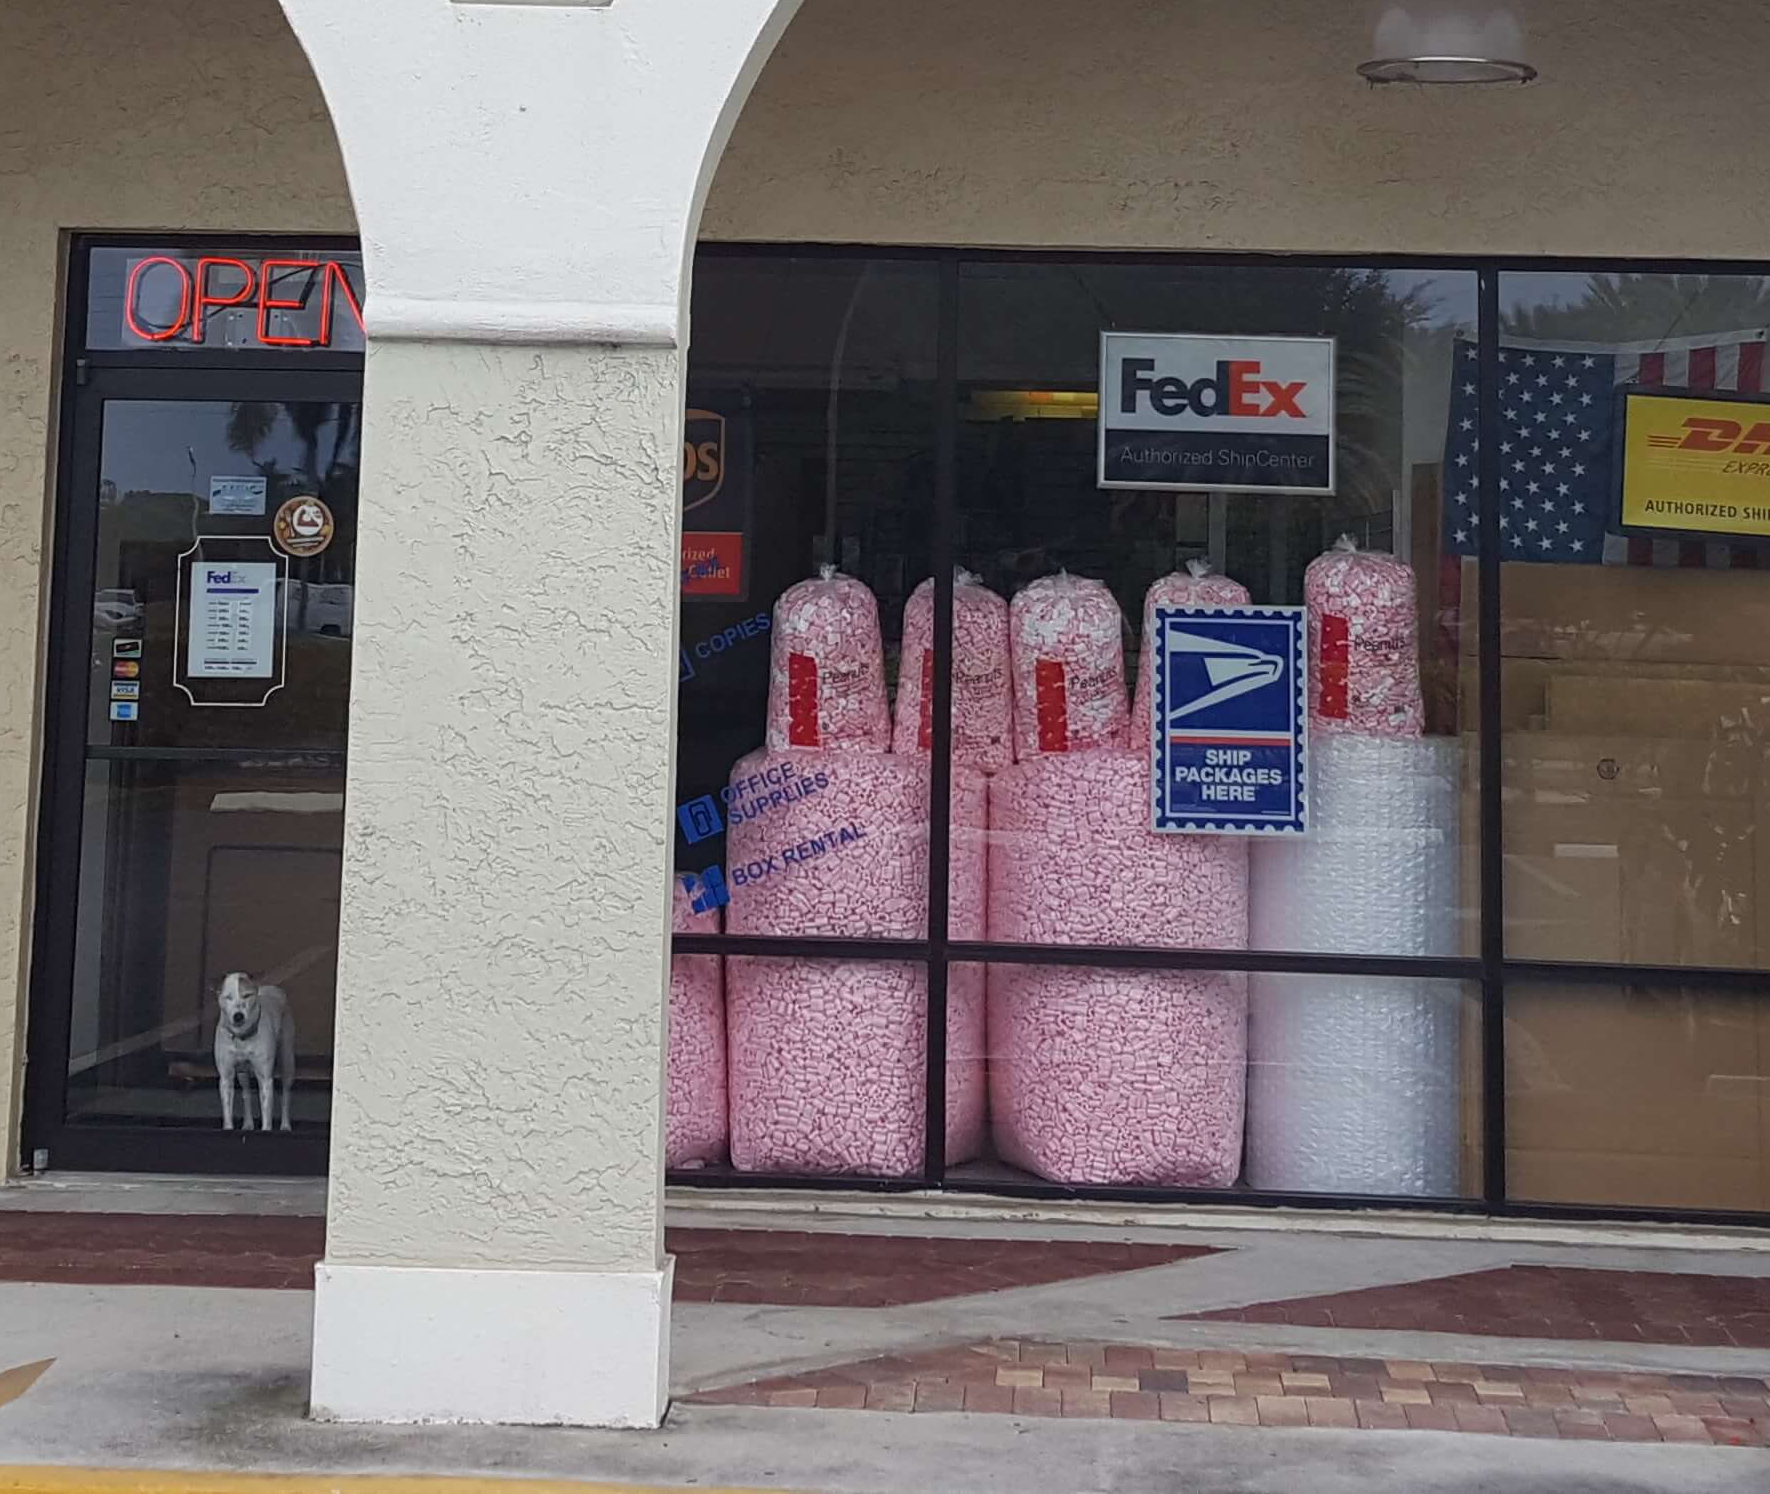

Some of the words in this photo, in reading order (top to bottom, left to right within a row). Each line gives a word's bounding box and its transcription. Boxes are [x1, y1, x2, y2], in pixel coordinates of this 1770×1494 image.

[126, 256, 365, 347] OPEN
[1121, 357, 1308, 418] FedEx
[1120, 446, 1213, 466] Authorized
[1217, 449, 1314, 469] ShipCenter
[1644, 499, 1738, 518] AUTHORIZED
[695, 612, 770, 659] COPIES
[1174, 766, 1283, 785] PACKAGES
[1205, 749, 1252, 766] SHIP
[720, 761, 797, 803] OFFICE
[728, 772, 830, 826] SUPPLIES
[1201, 784, 1256, 802] HERE
[732, 857, 780, 887] BOX
[782, 823, 868, 867] RENTAL
